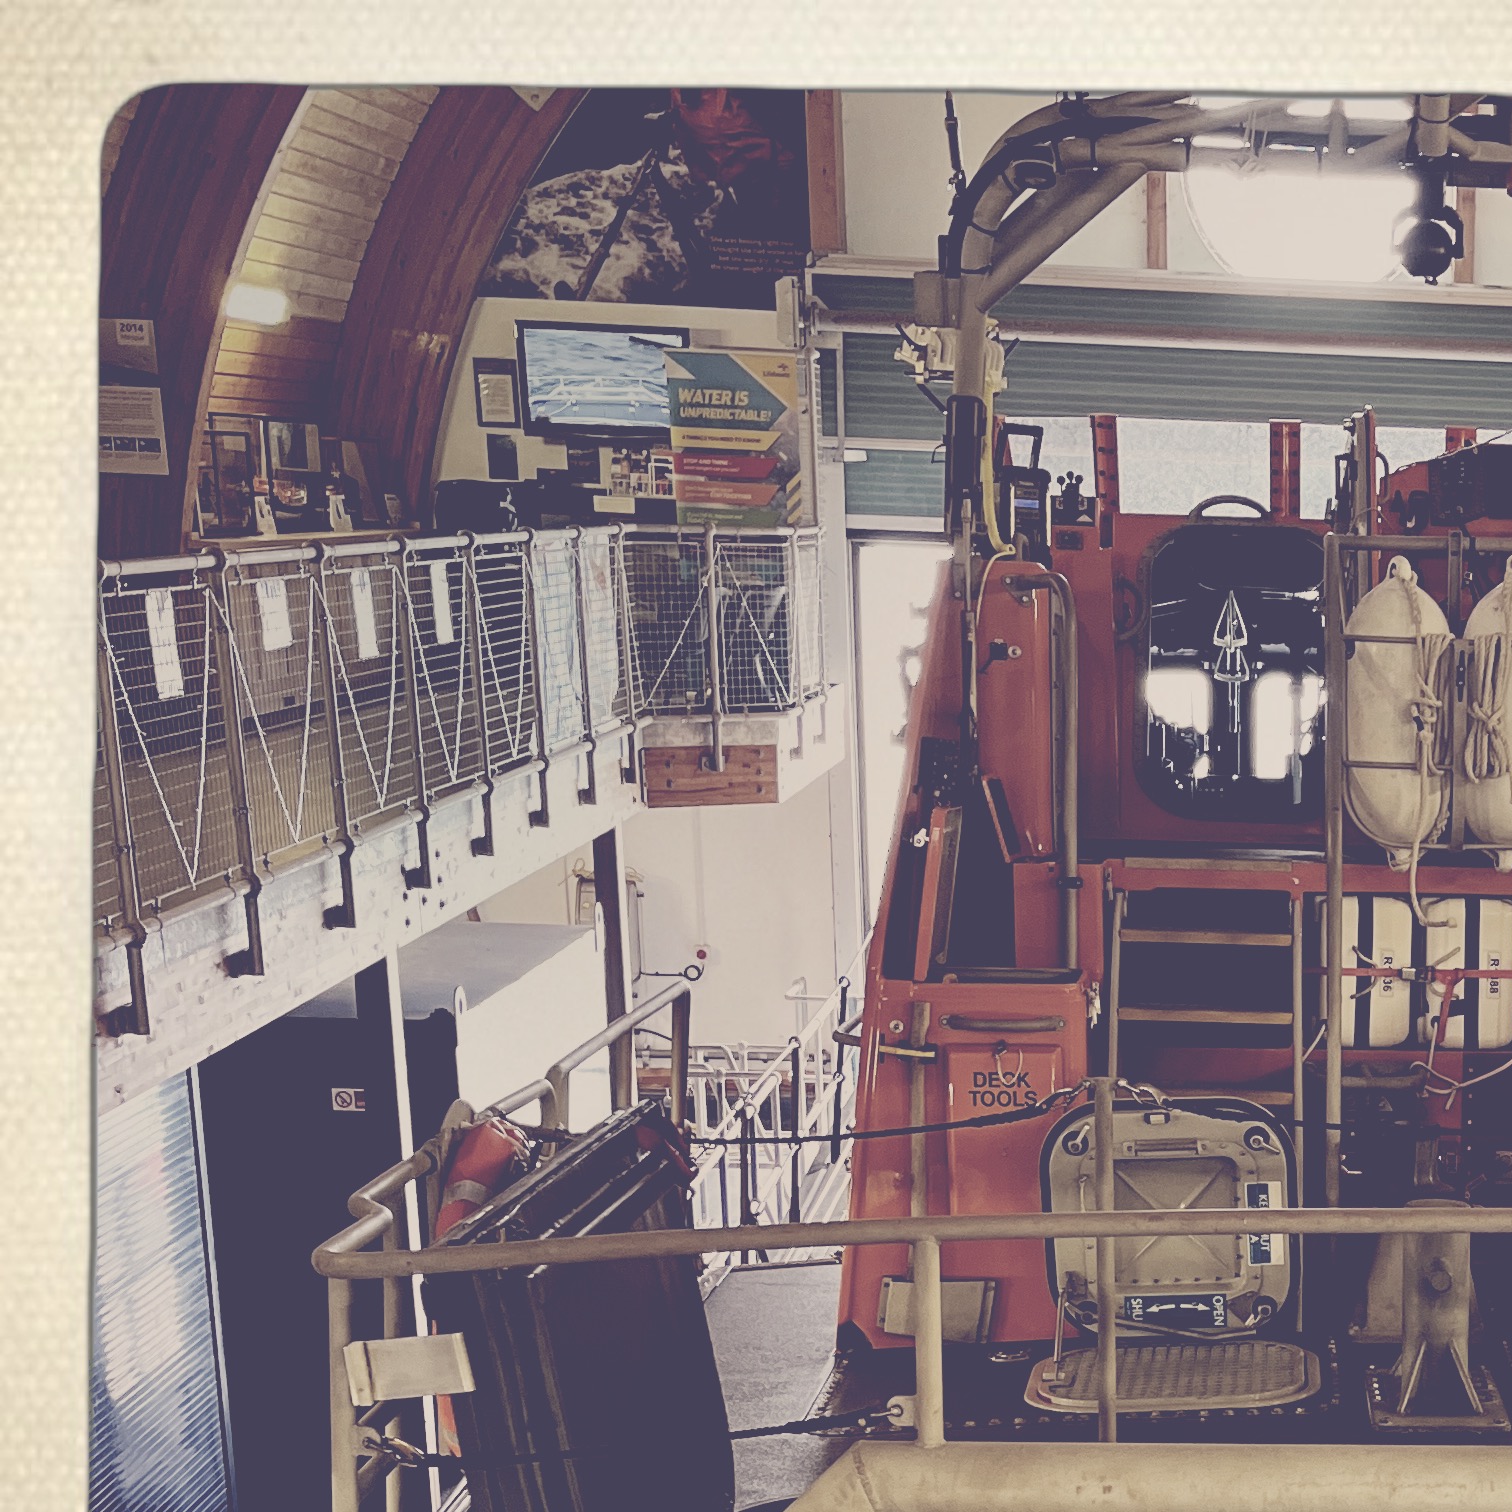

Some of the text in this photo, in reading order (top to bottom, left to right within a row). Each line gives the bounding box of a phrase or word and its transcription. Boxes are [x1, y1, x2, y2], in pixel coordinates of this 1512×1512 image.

[119, 322, 144, 333] 2014
[678, 387, 749, 406] WATER IS
[679, 406, 772, 422] UNPREDICTABLE!
[972, 1071, 1031, 1088] DECK
[968, 1090, 1038, 1107] TOOLS
[1130, 1298, 1144, 1321] SHU
[1212, 1295, 1225, 1326] OPEN
